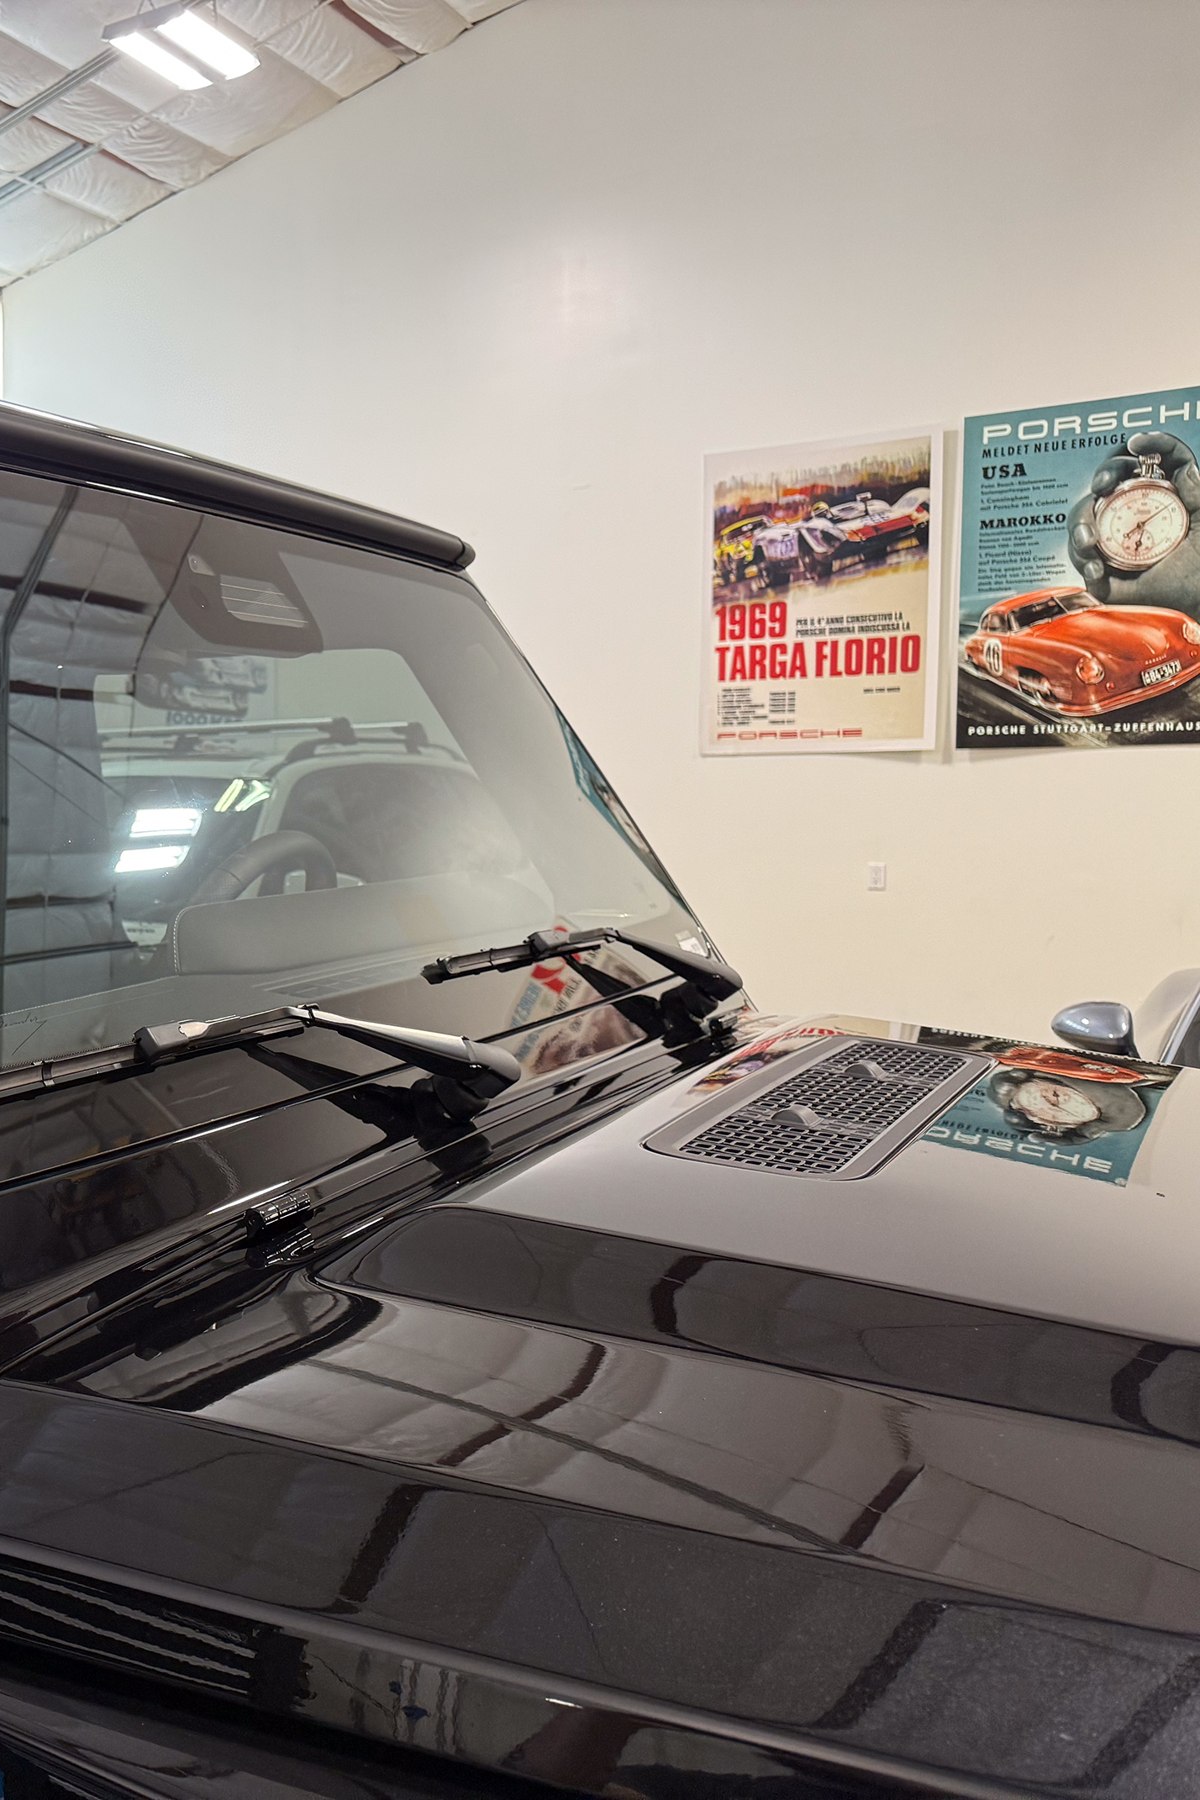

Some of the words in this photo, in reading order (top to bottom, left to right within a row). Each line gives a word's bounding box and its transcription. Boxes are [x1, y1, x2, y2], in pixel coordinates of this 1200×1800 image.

[982, 401, 1200, 445] PORSCH
[981, 443, 1030, 459] MELDET
[1033, 439, 1067, 453] NEUE
[1071, 432, 1127, 450] ERFOLGE
[982, 463, 1027, 480] USA
[980, 513, 1067, 530] MAROKKO
[715, 601, 788, 641] 1969
[845, 612, 893, 625] CONSECUTIVO
[894, 610, 903, 621] LA
[796, 627, 827, 637] PORSCHE
[828, 625, 856, 636] DOMINA
[857, 623, 900, 633] INDISCUSSA
[902, 621, 911, 631] LA
[715, 642, 808, 682] TARGA
[815, 634, 921, 678] FLORIO
[717, 729, 863, 741] PORSCHE
[968, 725, 1026, 736] PORSCHE
